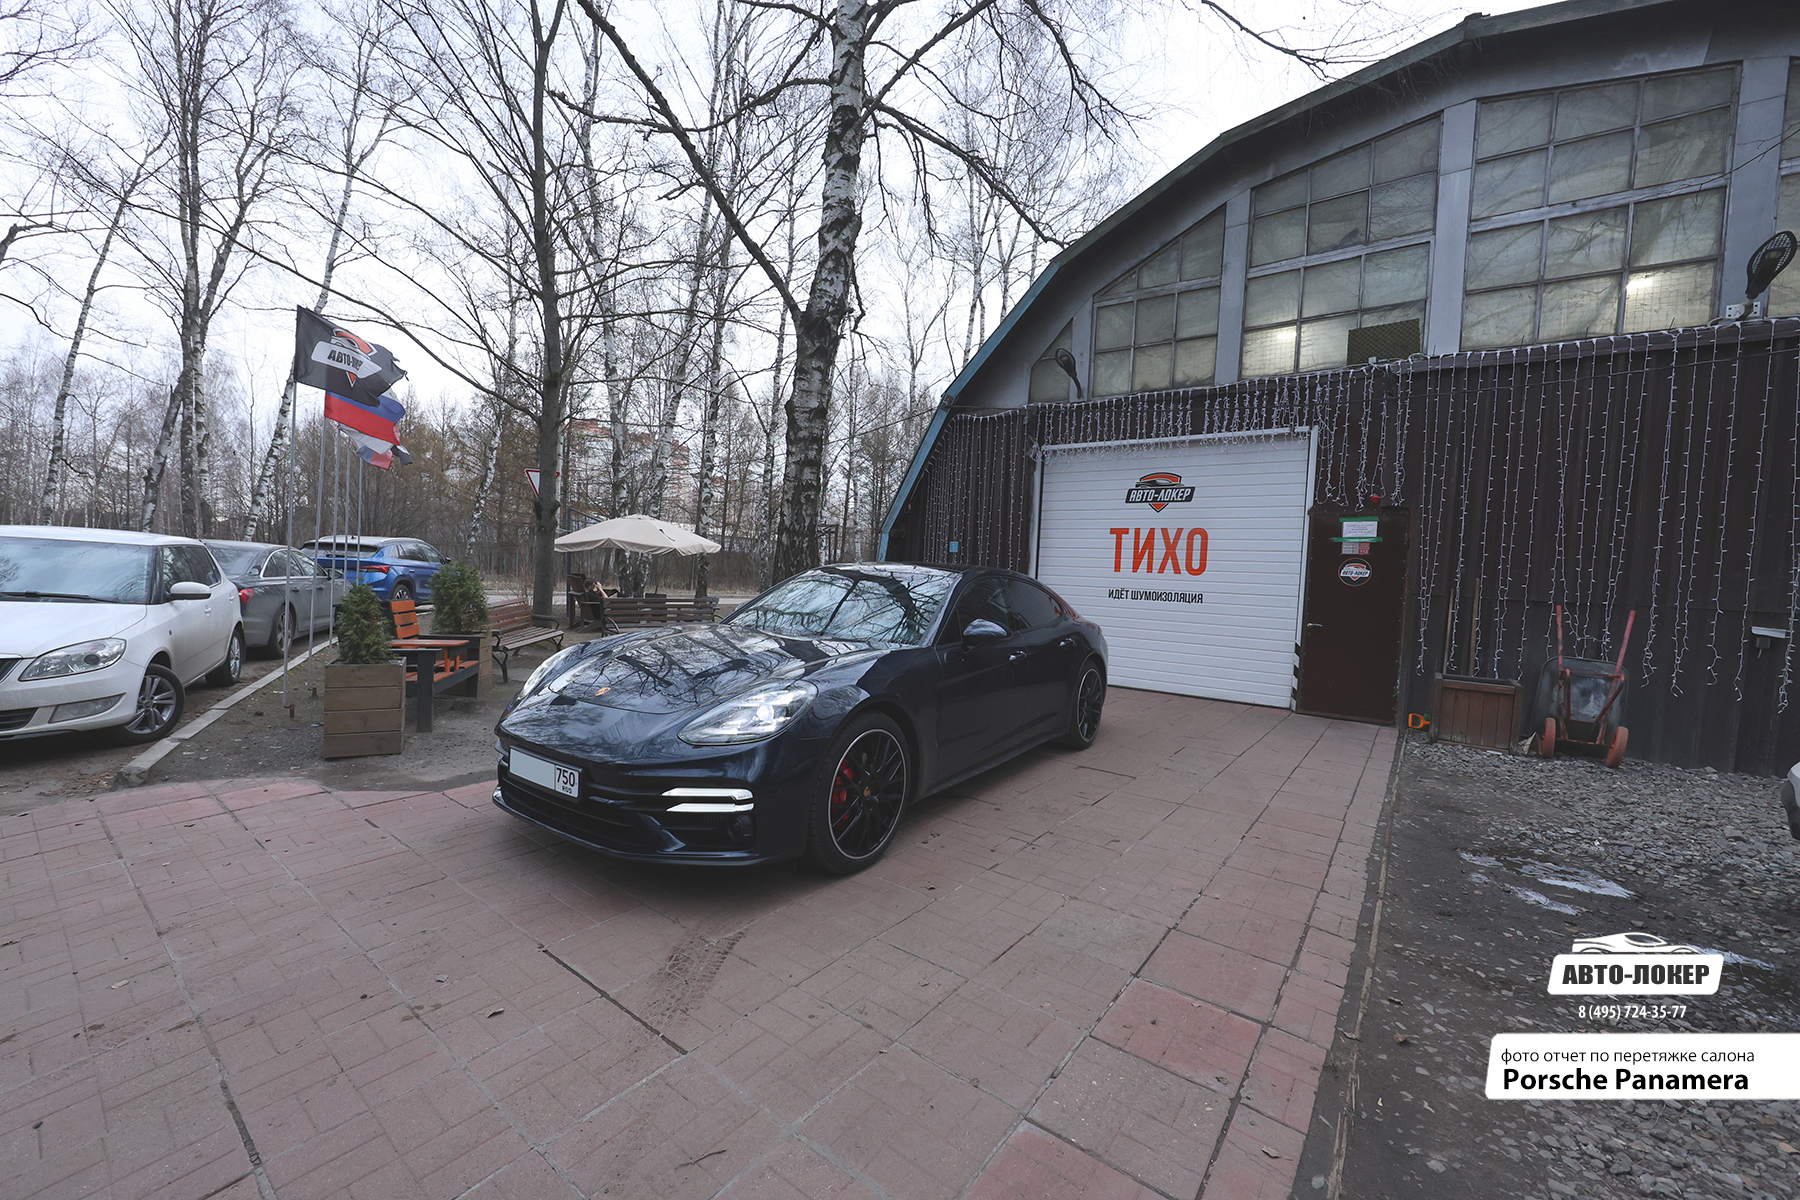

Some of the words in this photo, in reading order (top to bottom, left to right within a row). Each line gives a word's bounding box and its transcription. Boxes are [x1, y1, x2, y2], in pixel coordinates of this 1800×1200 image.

[327, 349, 364, 371] АВТО-
[1128, 488, 1192, 502] АВТО-ЛОКЕР
[1109, 527, 1209, 576] ТИХО
[1108, 588, 1130, 600] ИДЁТ
[1131, 590, 1204, 604] ШУМОИЗОЛЯЦИЯ
[556, 767, 576, 787] 750
